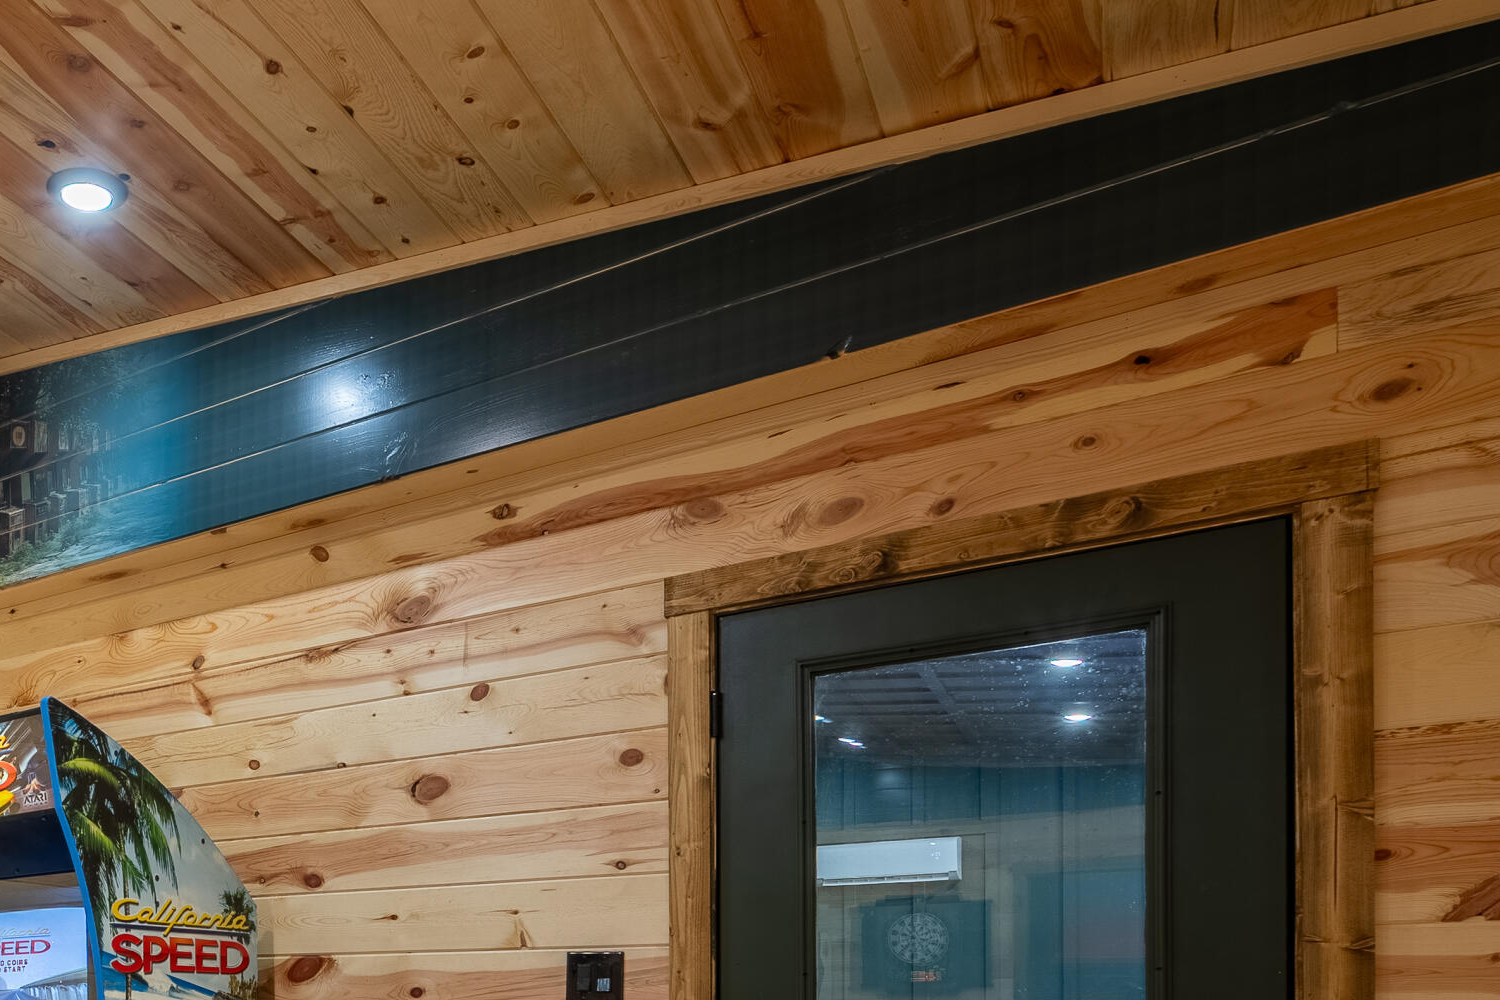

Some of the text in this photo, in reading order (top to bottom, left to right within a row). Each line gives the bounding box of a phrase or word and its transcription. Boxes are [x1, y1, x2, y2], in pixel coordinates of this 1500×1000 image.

[24, 792, 47, 804] ATARI
[111, 898, 250, 937] California
[111, 933, 250, 974] SPEED
[7, 958, 28, 966] COINS
[4, 965, 26, 973] START
